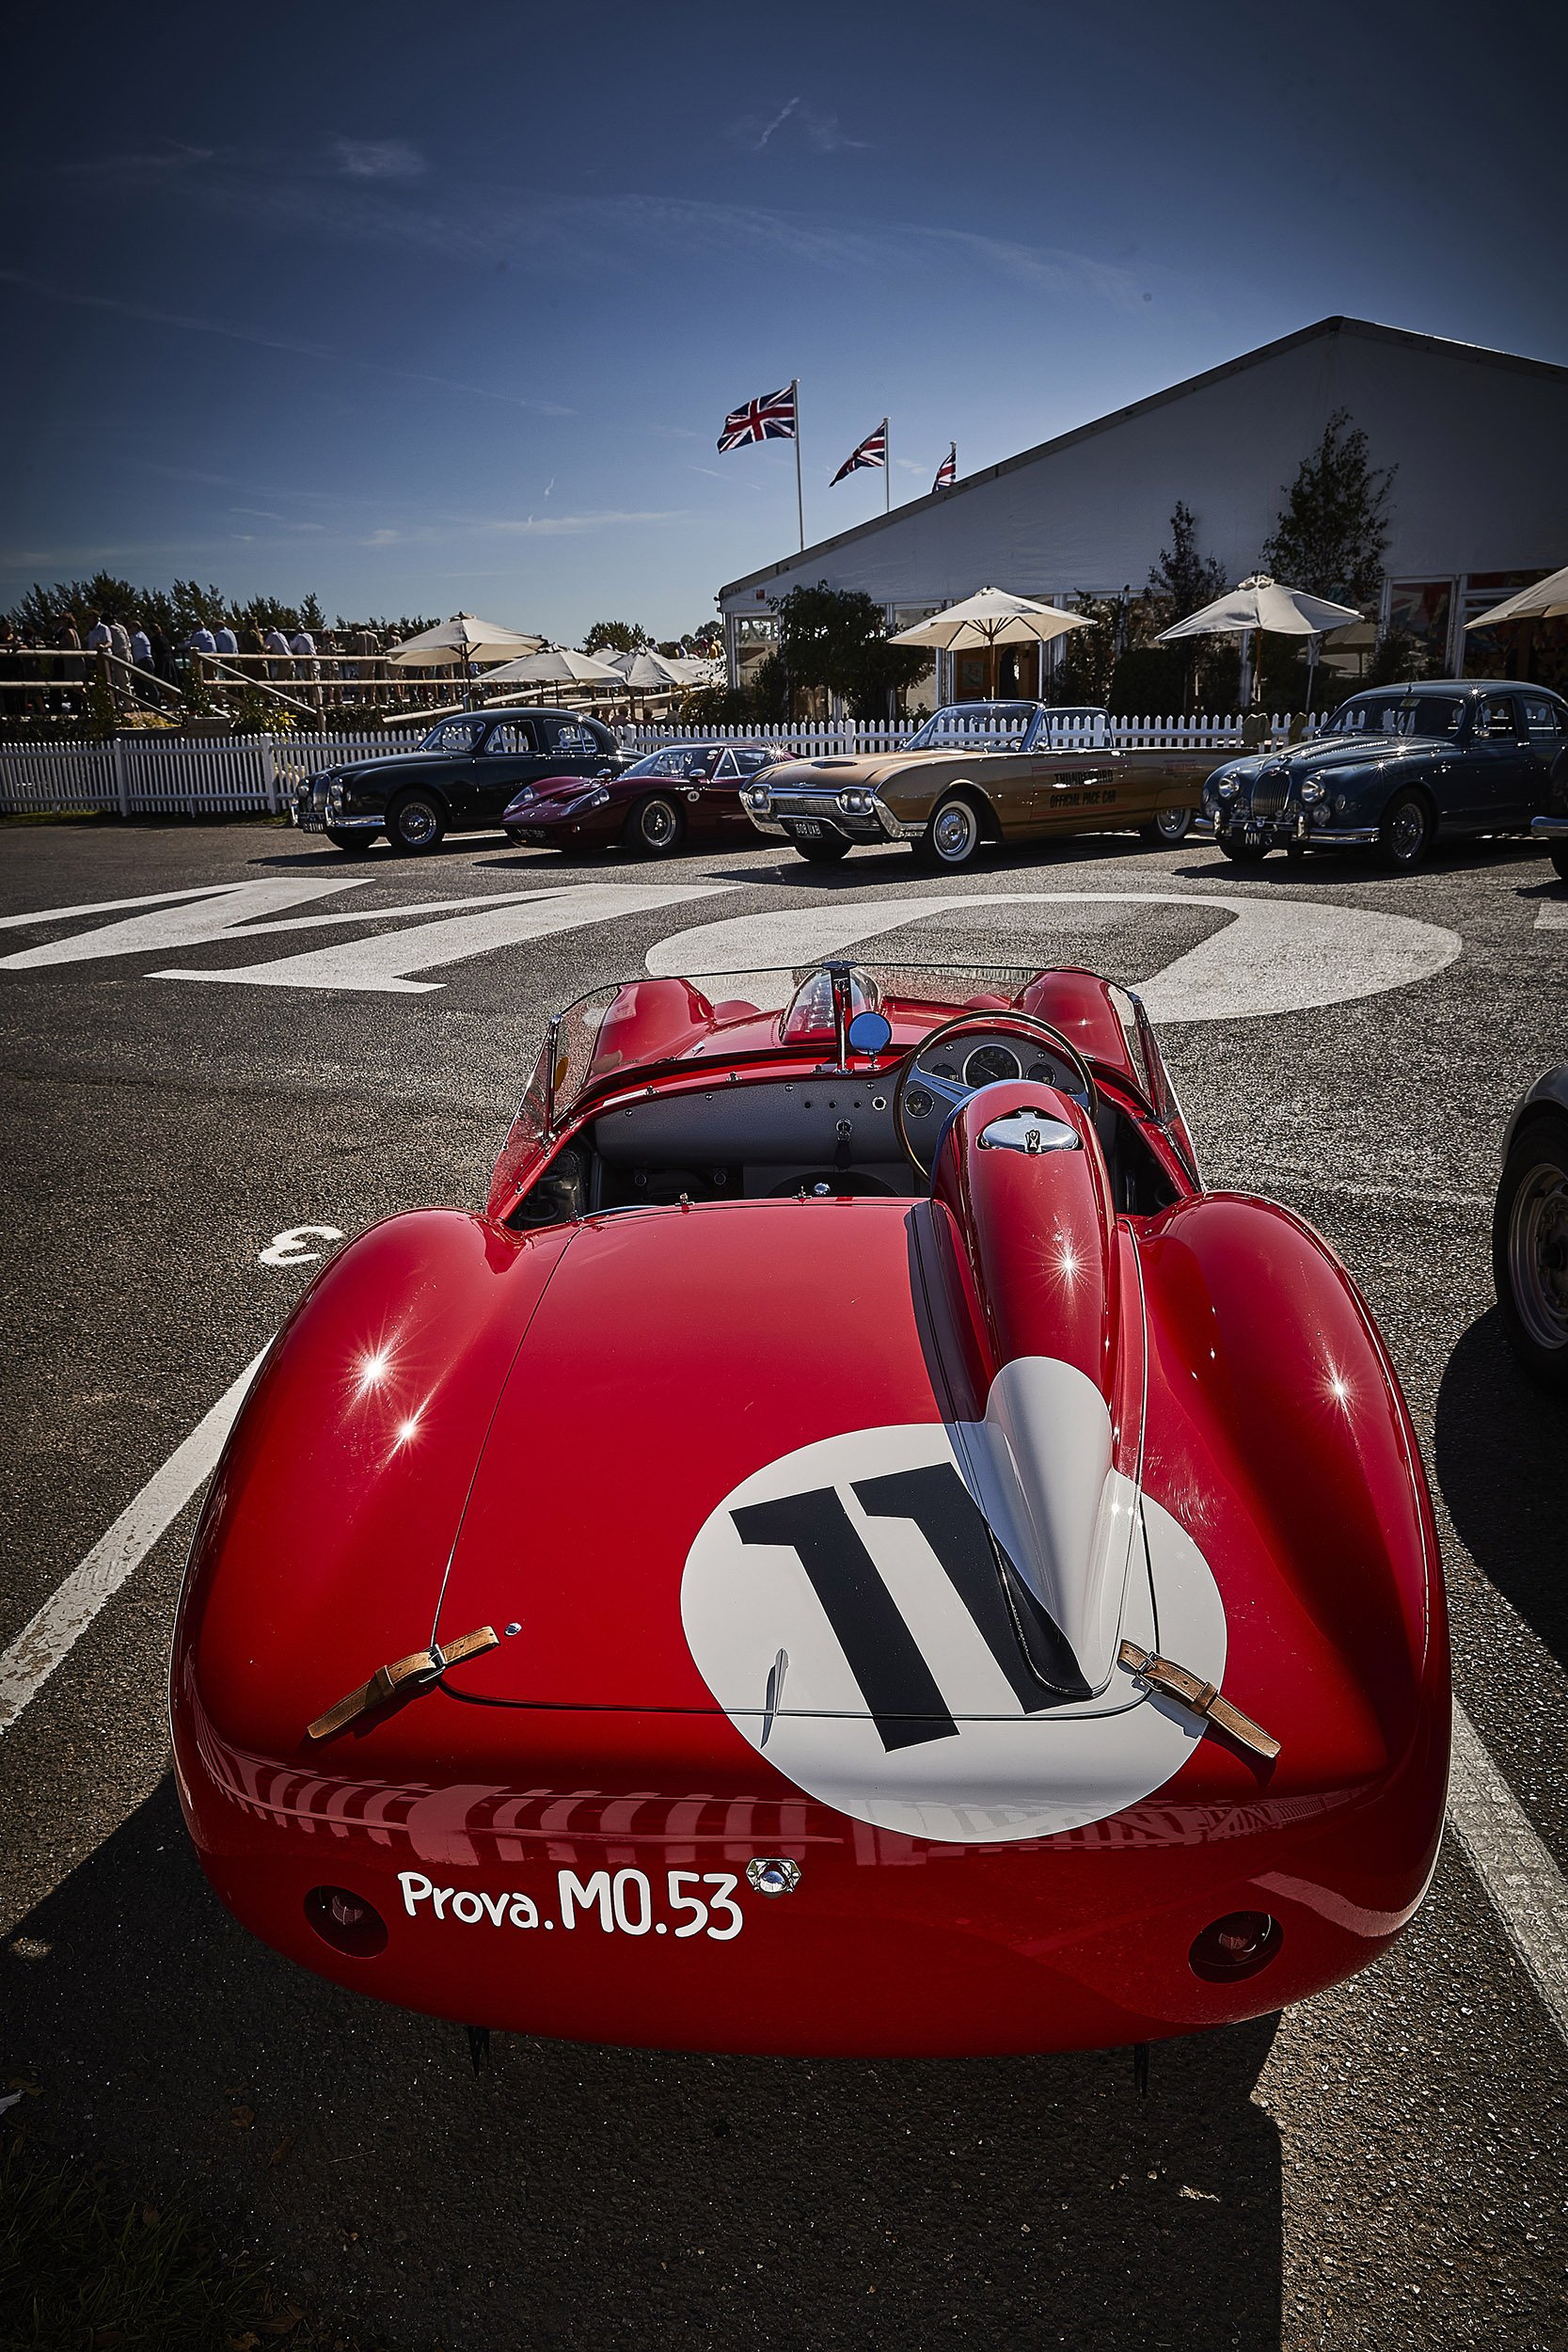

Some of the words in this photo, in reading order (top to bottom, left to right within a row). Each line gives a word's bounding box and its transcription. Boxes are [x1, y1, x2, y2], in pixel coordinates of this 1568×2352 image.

[1050, 793, 1081, 808] OFFICIAL
[1083, 791, 1101, 805] PACE
[1102, 789, 1117, 803] CAR
[728, 1461, 1094, 1753] 11
